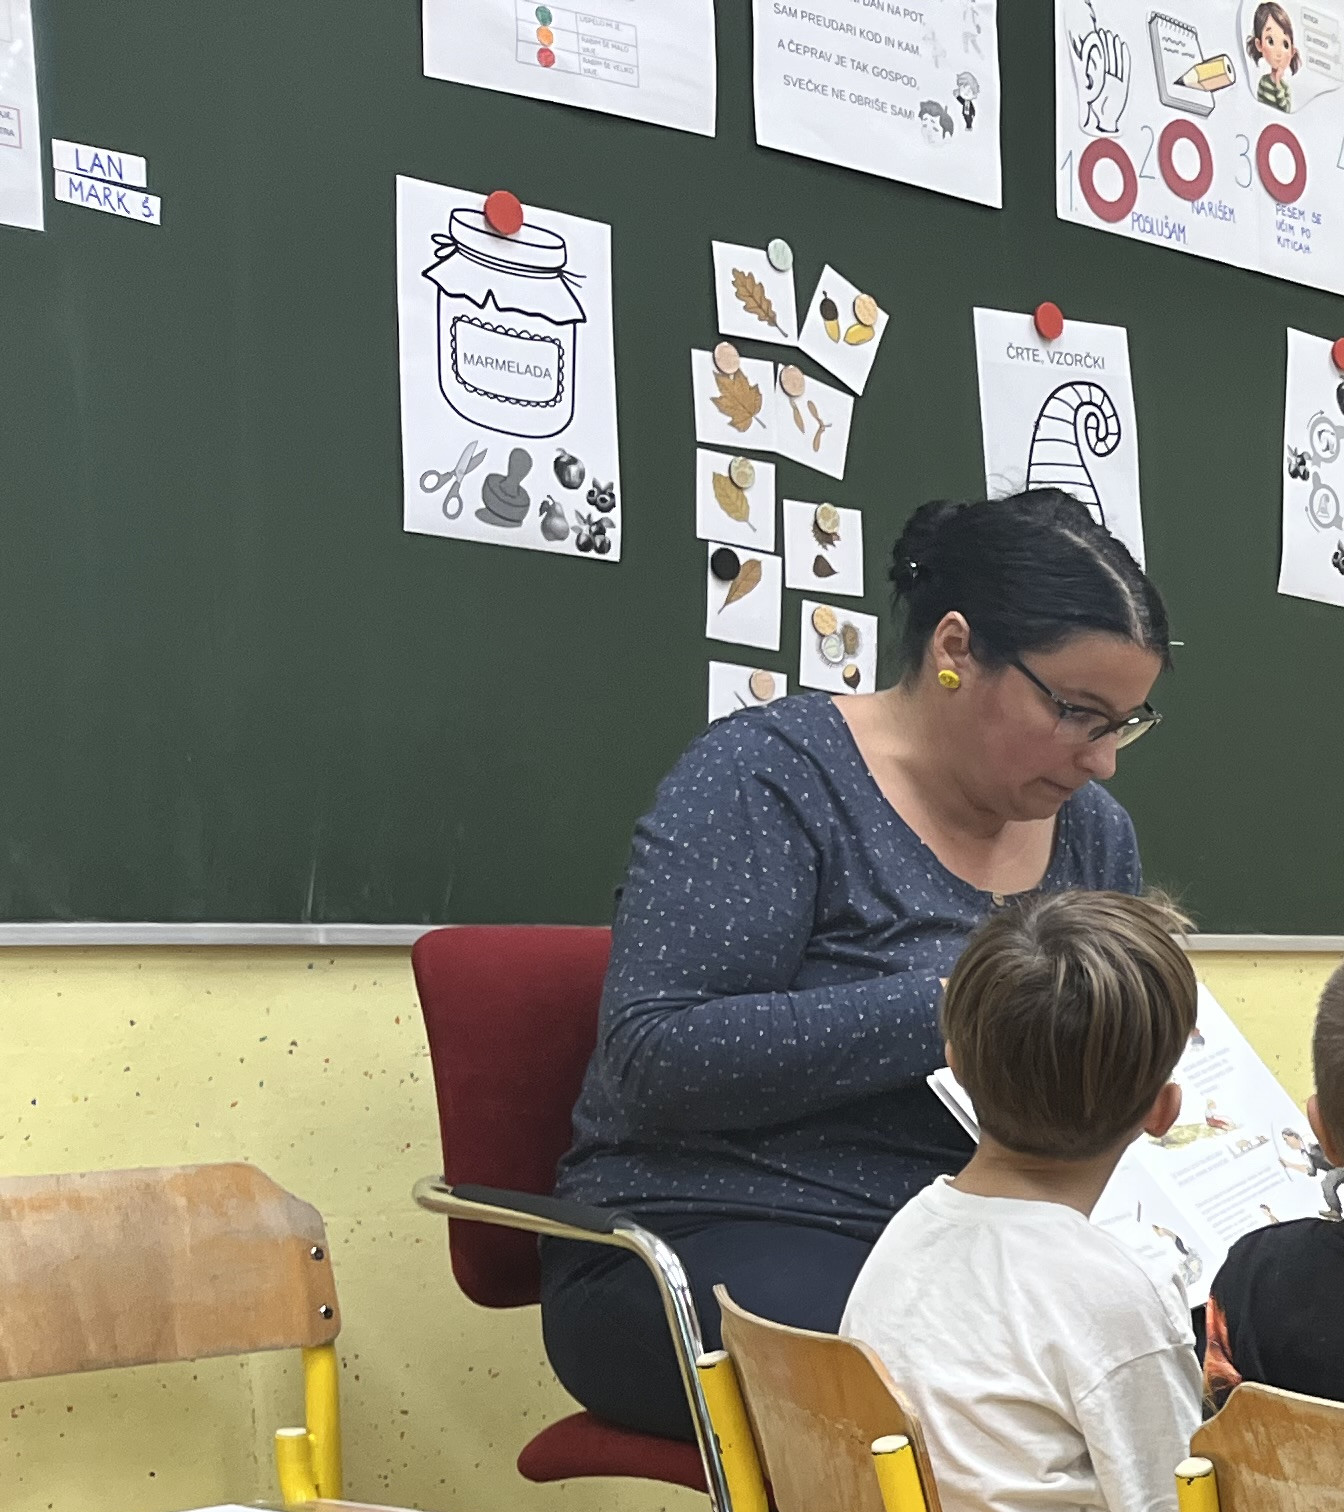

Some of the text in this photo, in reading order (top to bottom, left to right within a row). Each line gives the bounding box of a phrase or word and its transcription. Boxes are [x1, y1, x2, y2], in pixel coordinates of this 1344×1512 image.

[773, 2, 798, 20] SAM
[800, 10, 857, 37] PREUDARI
[859, 27, 882, 45] KOD
[884, 35, 896, 49] IN
[887, 2, 902, 17] NA
[777, 38, 786, 51] A
[788, 39, 833, 63] ČEPRAV
[834, 54, 848, 69] JE
[850, 58, 870, 75] TAK
[783, 73, 829, 97] SVEČKE
[831, 87, 847, 102] NE
[849, 92, 888, 114] OBRIŠE
[74, 147, 124, 182] LAN
[68, 176, 131, 215] MARK
[463, 352, 553, 381] MARMELADA
[1046, 350, 1105, 370] VZORČKI
